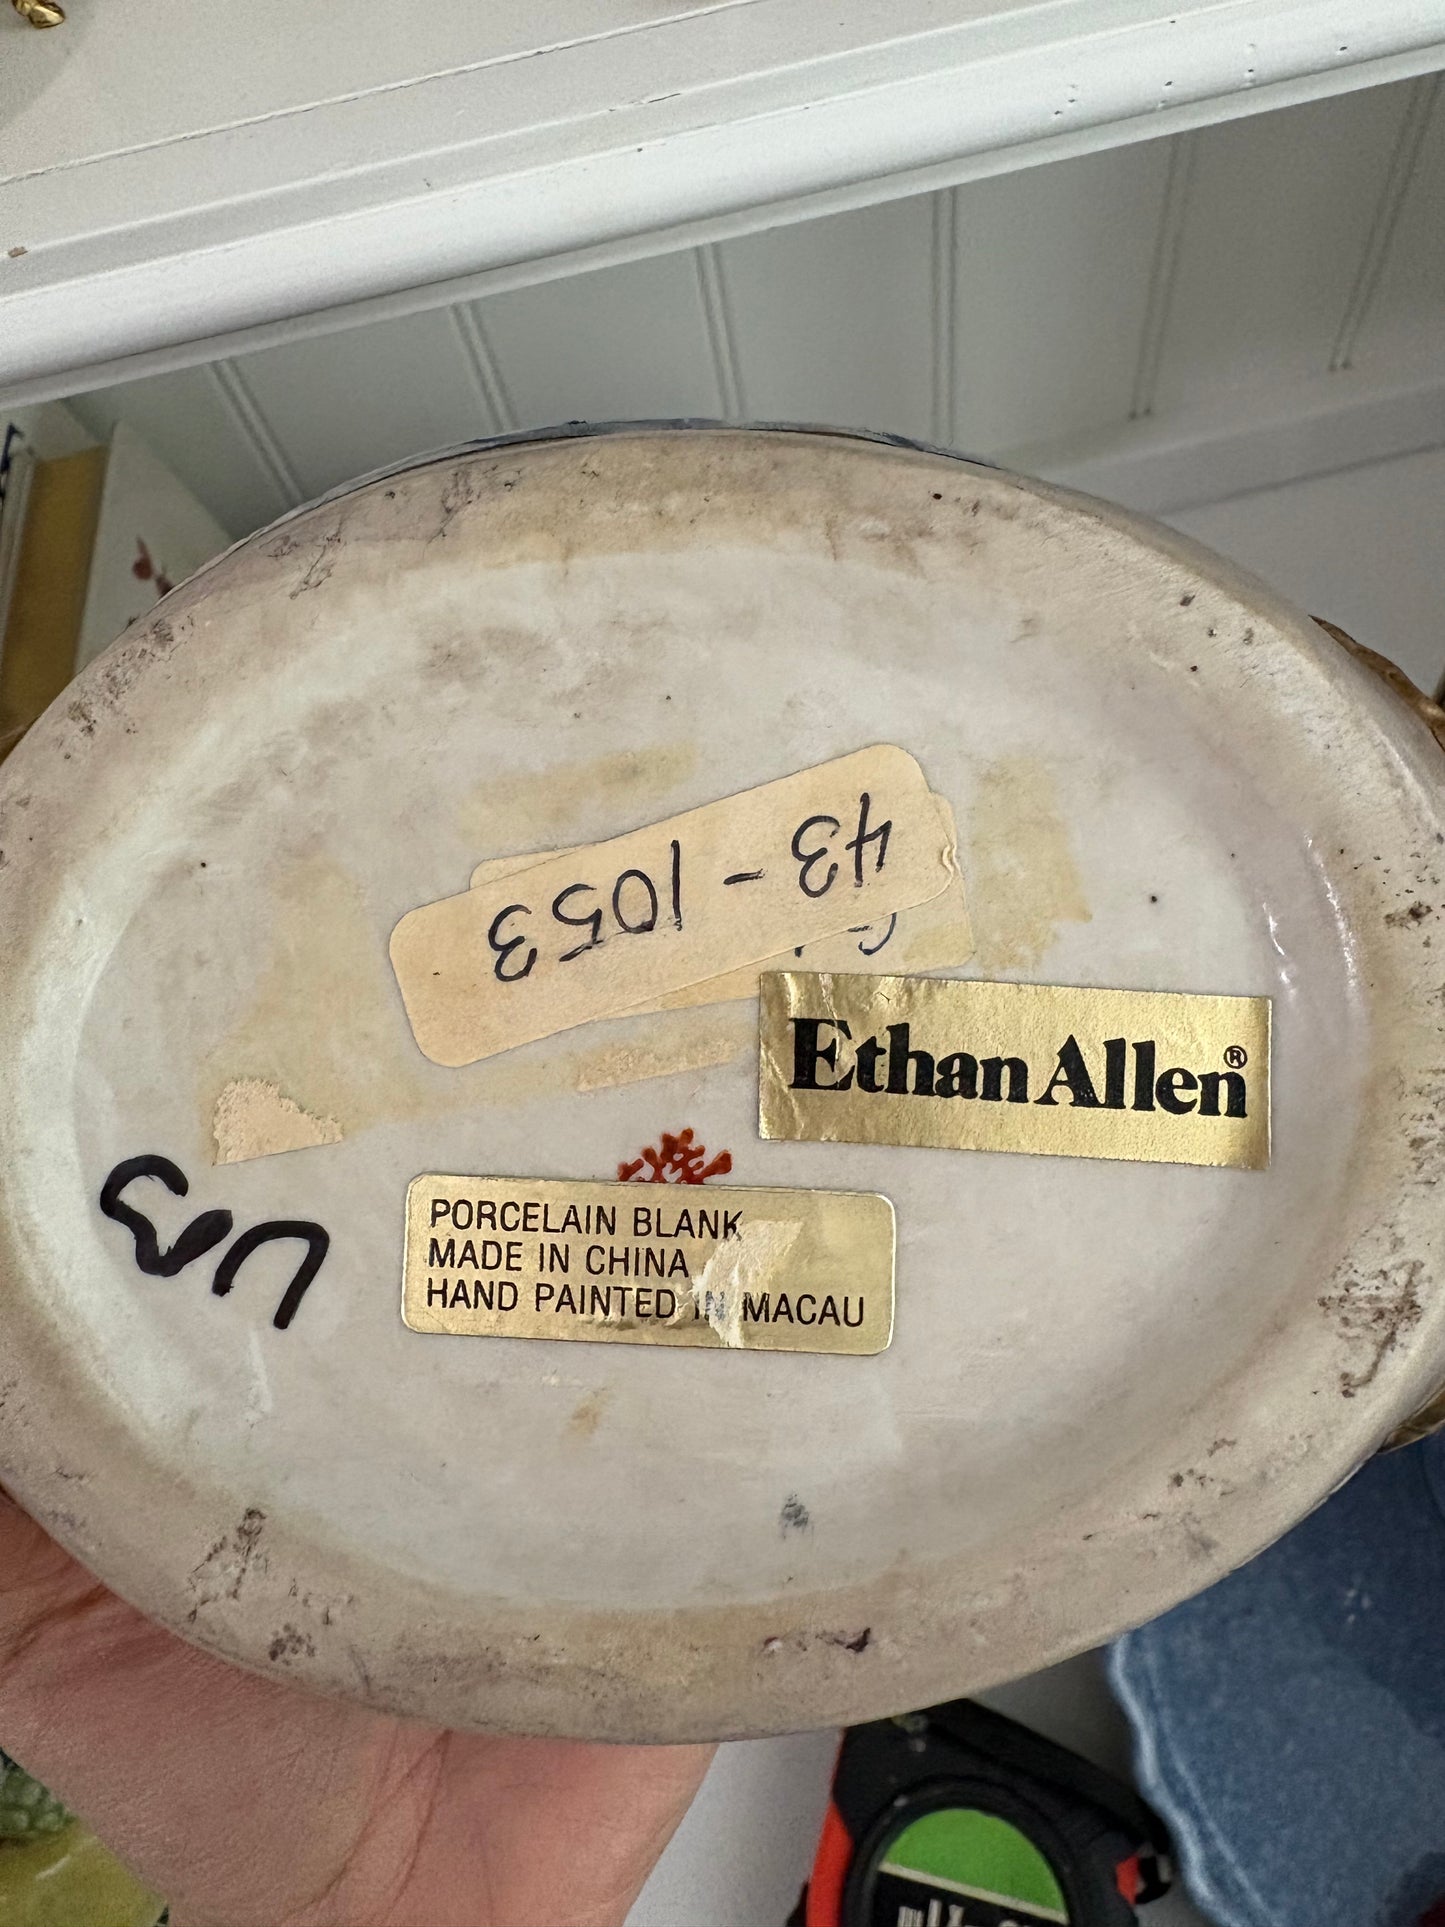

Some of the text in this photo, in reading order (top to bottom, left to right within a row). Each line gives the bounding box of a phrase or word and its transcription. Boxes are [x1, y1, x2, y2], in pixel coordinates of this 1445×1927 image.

[788, 1017, 1029, 1103] Ethan
[431, 1199, 743, 1240] PORCELAIN BLANK
[428, 1238, 690, 1278] MADE IN CHINA
[427, 1277, 519, 1312] HAND
[535, 1282, 676, 1319] PAINTED
[743, 1291, 864, 1328] MACAU
